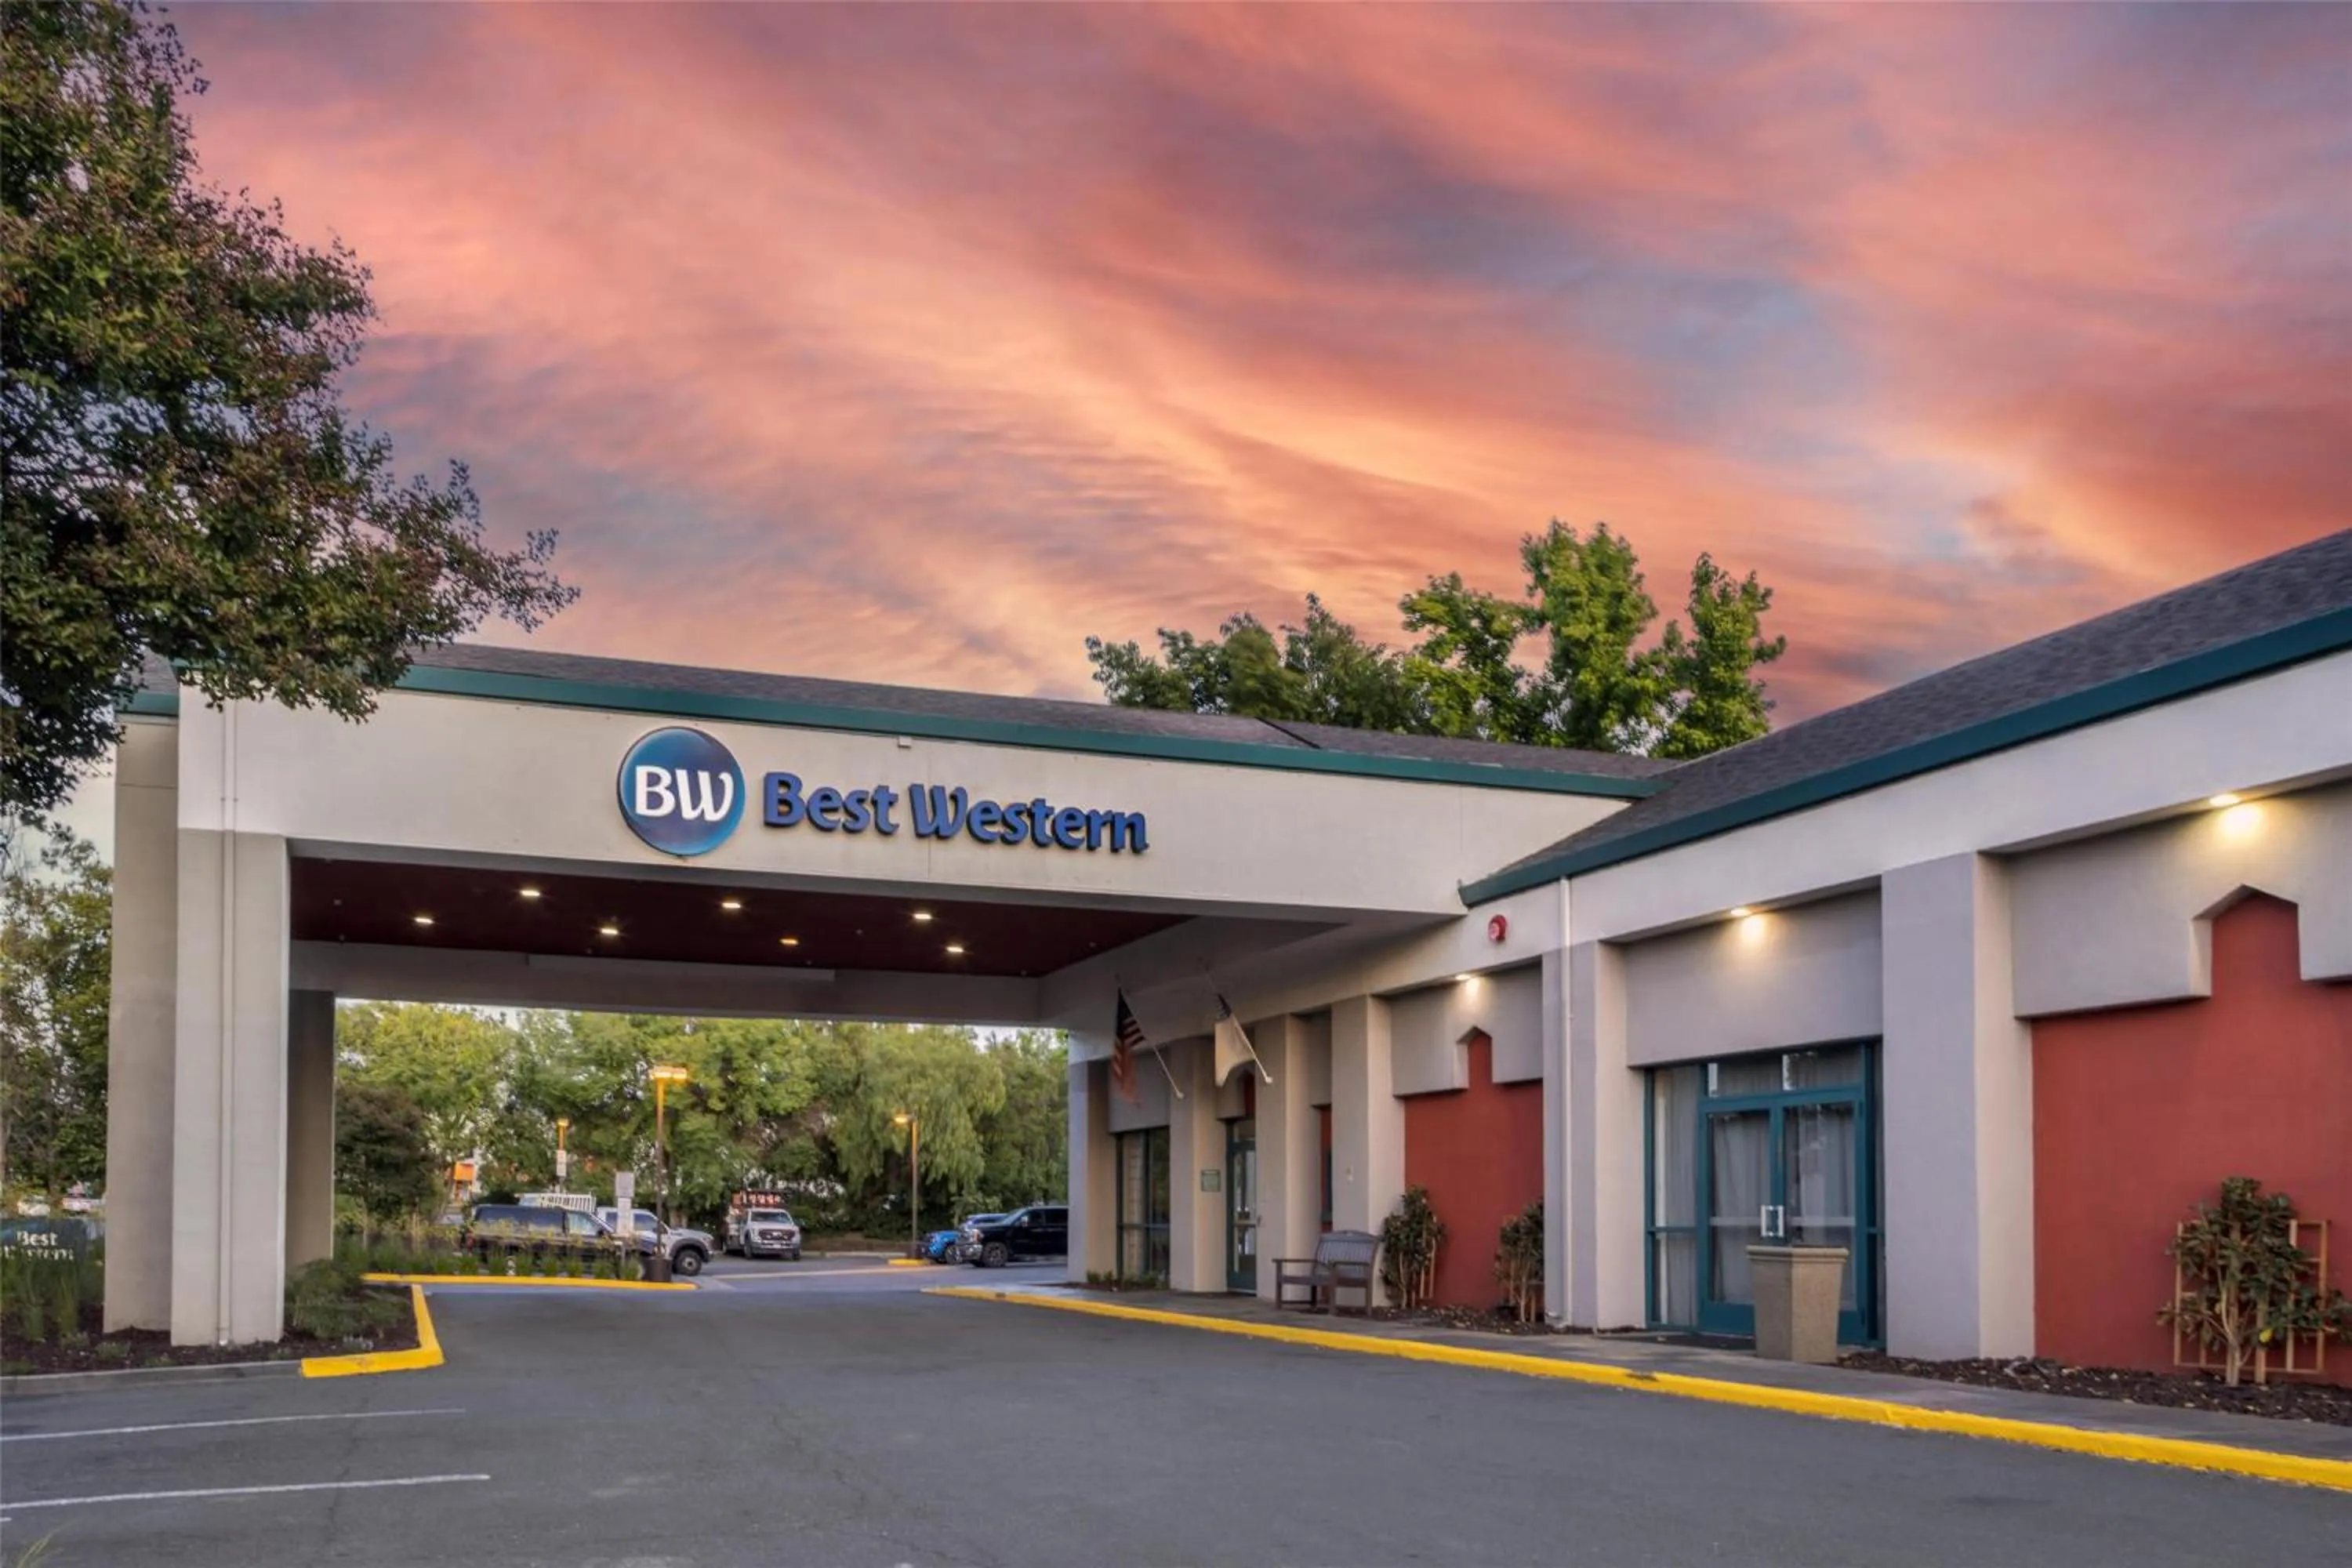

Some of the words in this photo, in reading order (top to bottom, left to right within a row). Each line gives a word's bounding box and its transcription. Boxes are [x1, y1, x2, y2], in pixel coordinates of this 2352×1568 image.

[635, 765, 734, 822] BW
[764, 771, 899, 834] Best
[908, 783, 1149, 853] Western
